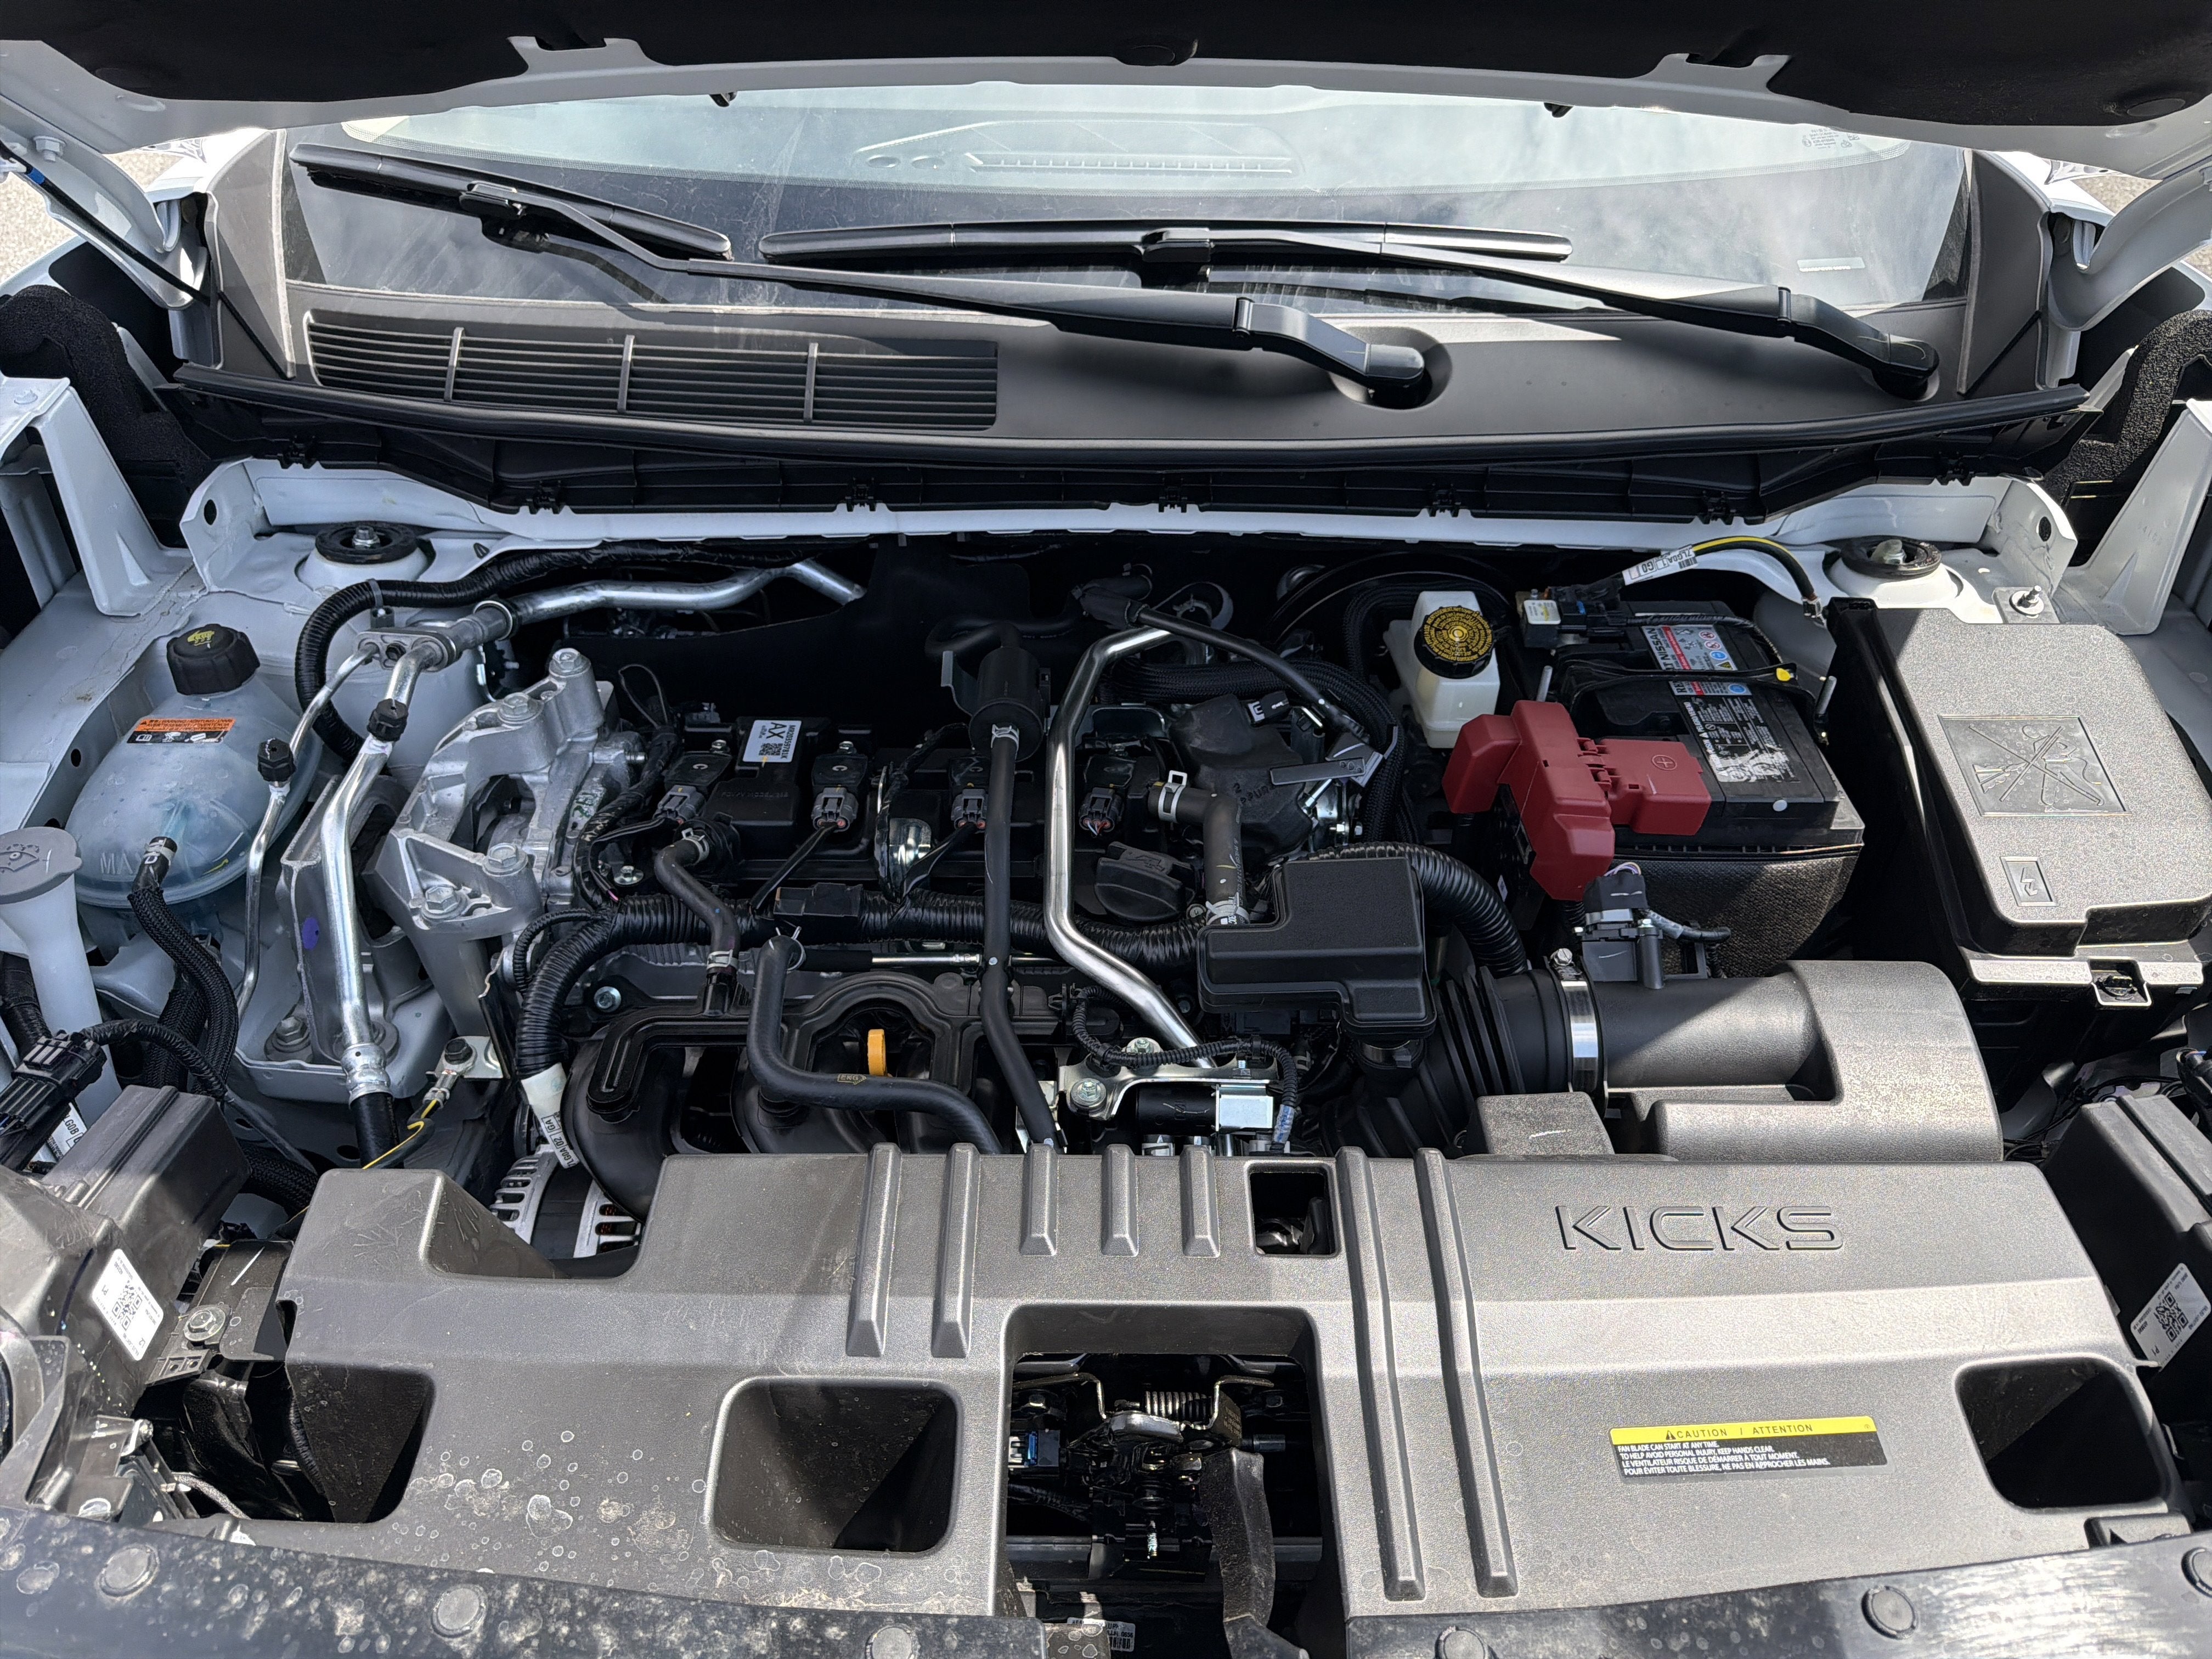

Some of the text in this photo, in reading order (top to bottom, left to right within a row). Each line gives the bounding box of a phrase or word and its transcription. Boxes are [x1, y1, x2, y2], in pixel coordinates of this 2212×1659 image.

[766, 721, 787, 739] AX
[1555, 1206, 1843, 1251] KICKS
[1677, 1428, 1728, 1439] CAUTION
[1753, 1424, 1813, 1435] ATTENTION
[1630, 1443, 1651, 1452] BLADE
[1664, 1442, 1682, 1450] START
[1646, 1451, 1664, 1459] AVOID
[1665, 1449, 1695, 1458] PERSONAL
[1733, 1446, 1754, 1454] HANDS
[1624, 1468, 1643, 1476] POUR
[1644, 1465, 1666, 1474] ÉVITER
[1666, 1465, 1688, 1474] TOUTE
[1755, 1460, 1794, 1469] APPROCHER
[1631, 1458, 1673, 1468] VENTILATEUR
[1673, 1457, 1698, 1465] RISQUE
[1708, 1454, 1743, 1463] DÉMARRER
